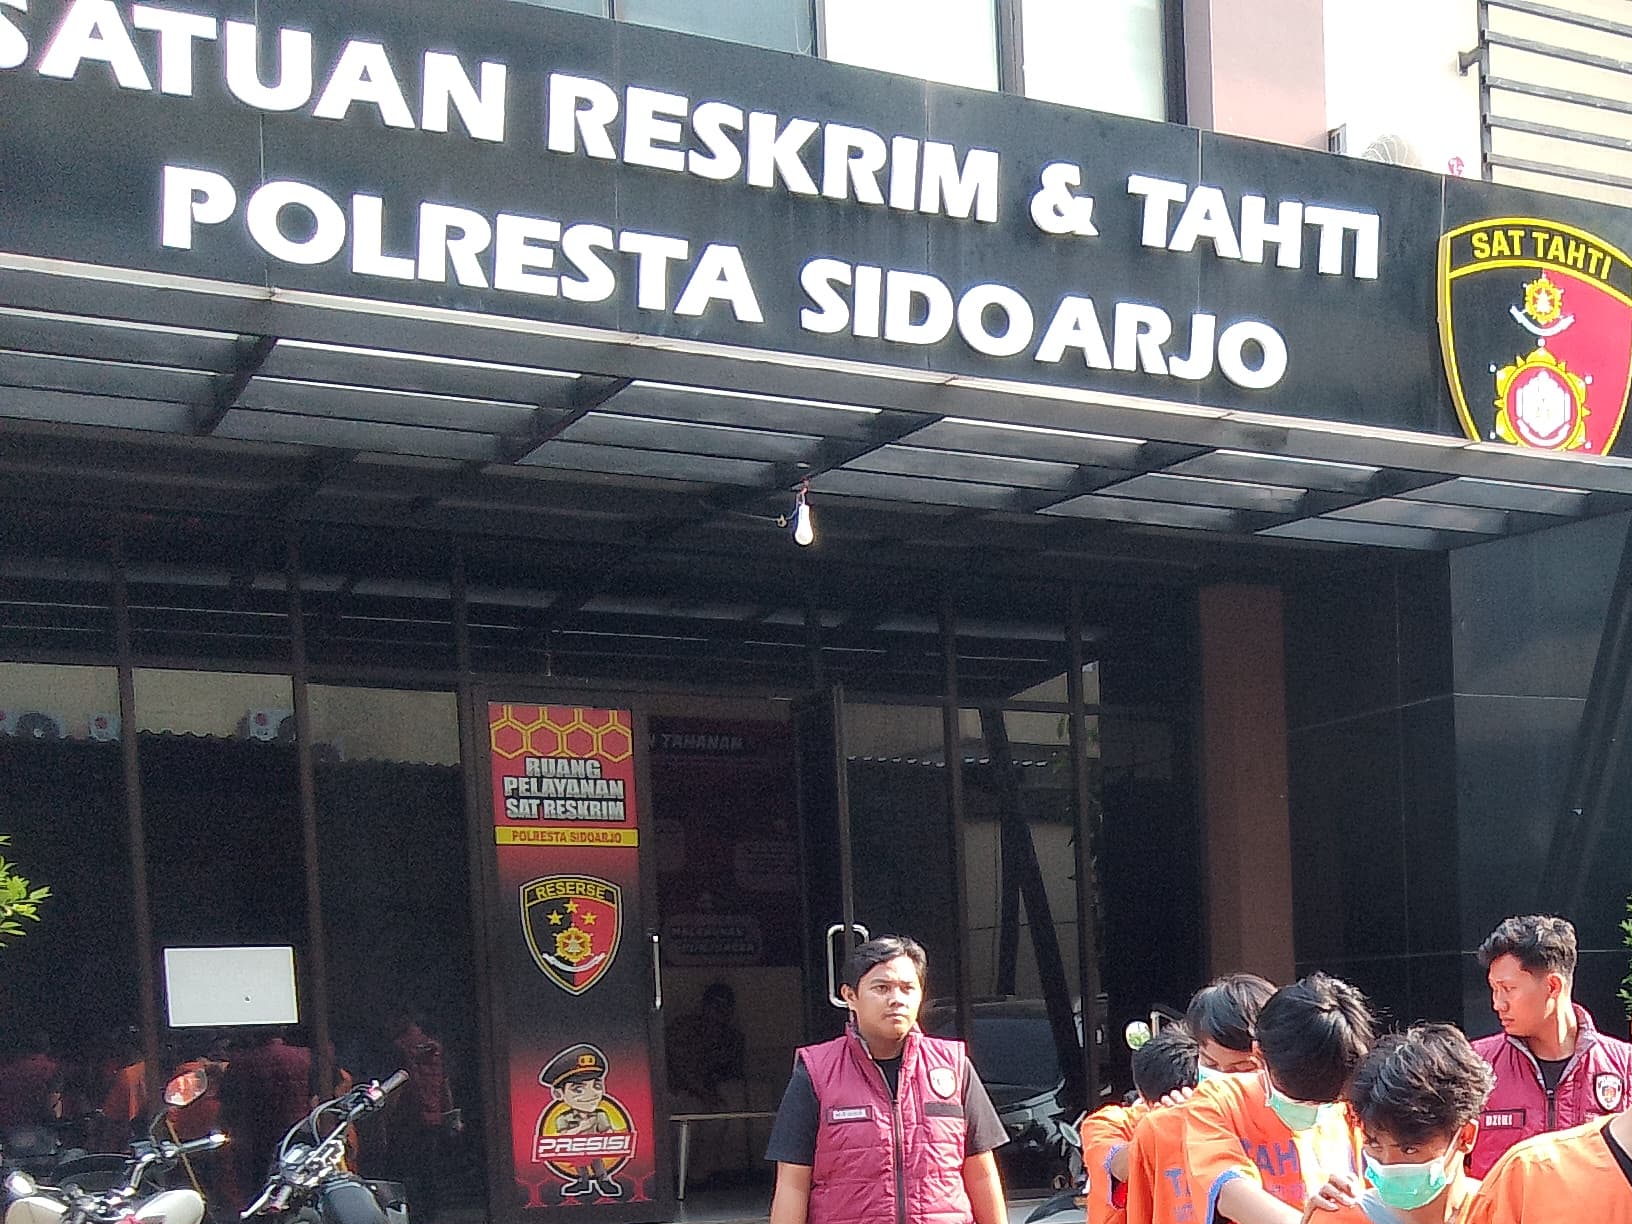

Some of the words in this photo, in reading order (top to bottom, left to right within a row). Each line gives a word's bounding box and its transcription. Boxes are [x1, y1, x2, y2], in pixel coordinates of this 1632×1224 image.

[547, 72, 999, 224] RESKRIM
[1030, 161, 1100, 237] &
[1127, 174, 1381, 281] TAHTI
[1471, 229, 1525, 260] SAT
[1531, 231, 1613, 281] TAHTI
[160, 164, 765, 324] POLRESTA
[800, 257, 1289, 390] SIDOARJO
[525, 757, 602, 779] RUANG
[503, 776, 625, 800] PELAYANAN
[506, 798, 540, 819] SAT
[543, 799, 625, 821] RESKRIM
[511, 830, 567, 842] POLRESTA
[569, 831, 622, 844] SIDOARJO
[535, 881, 606, 900] RESERSE
[538, 1134, 632, 1153] PRESISI
